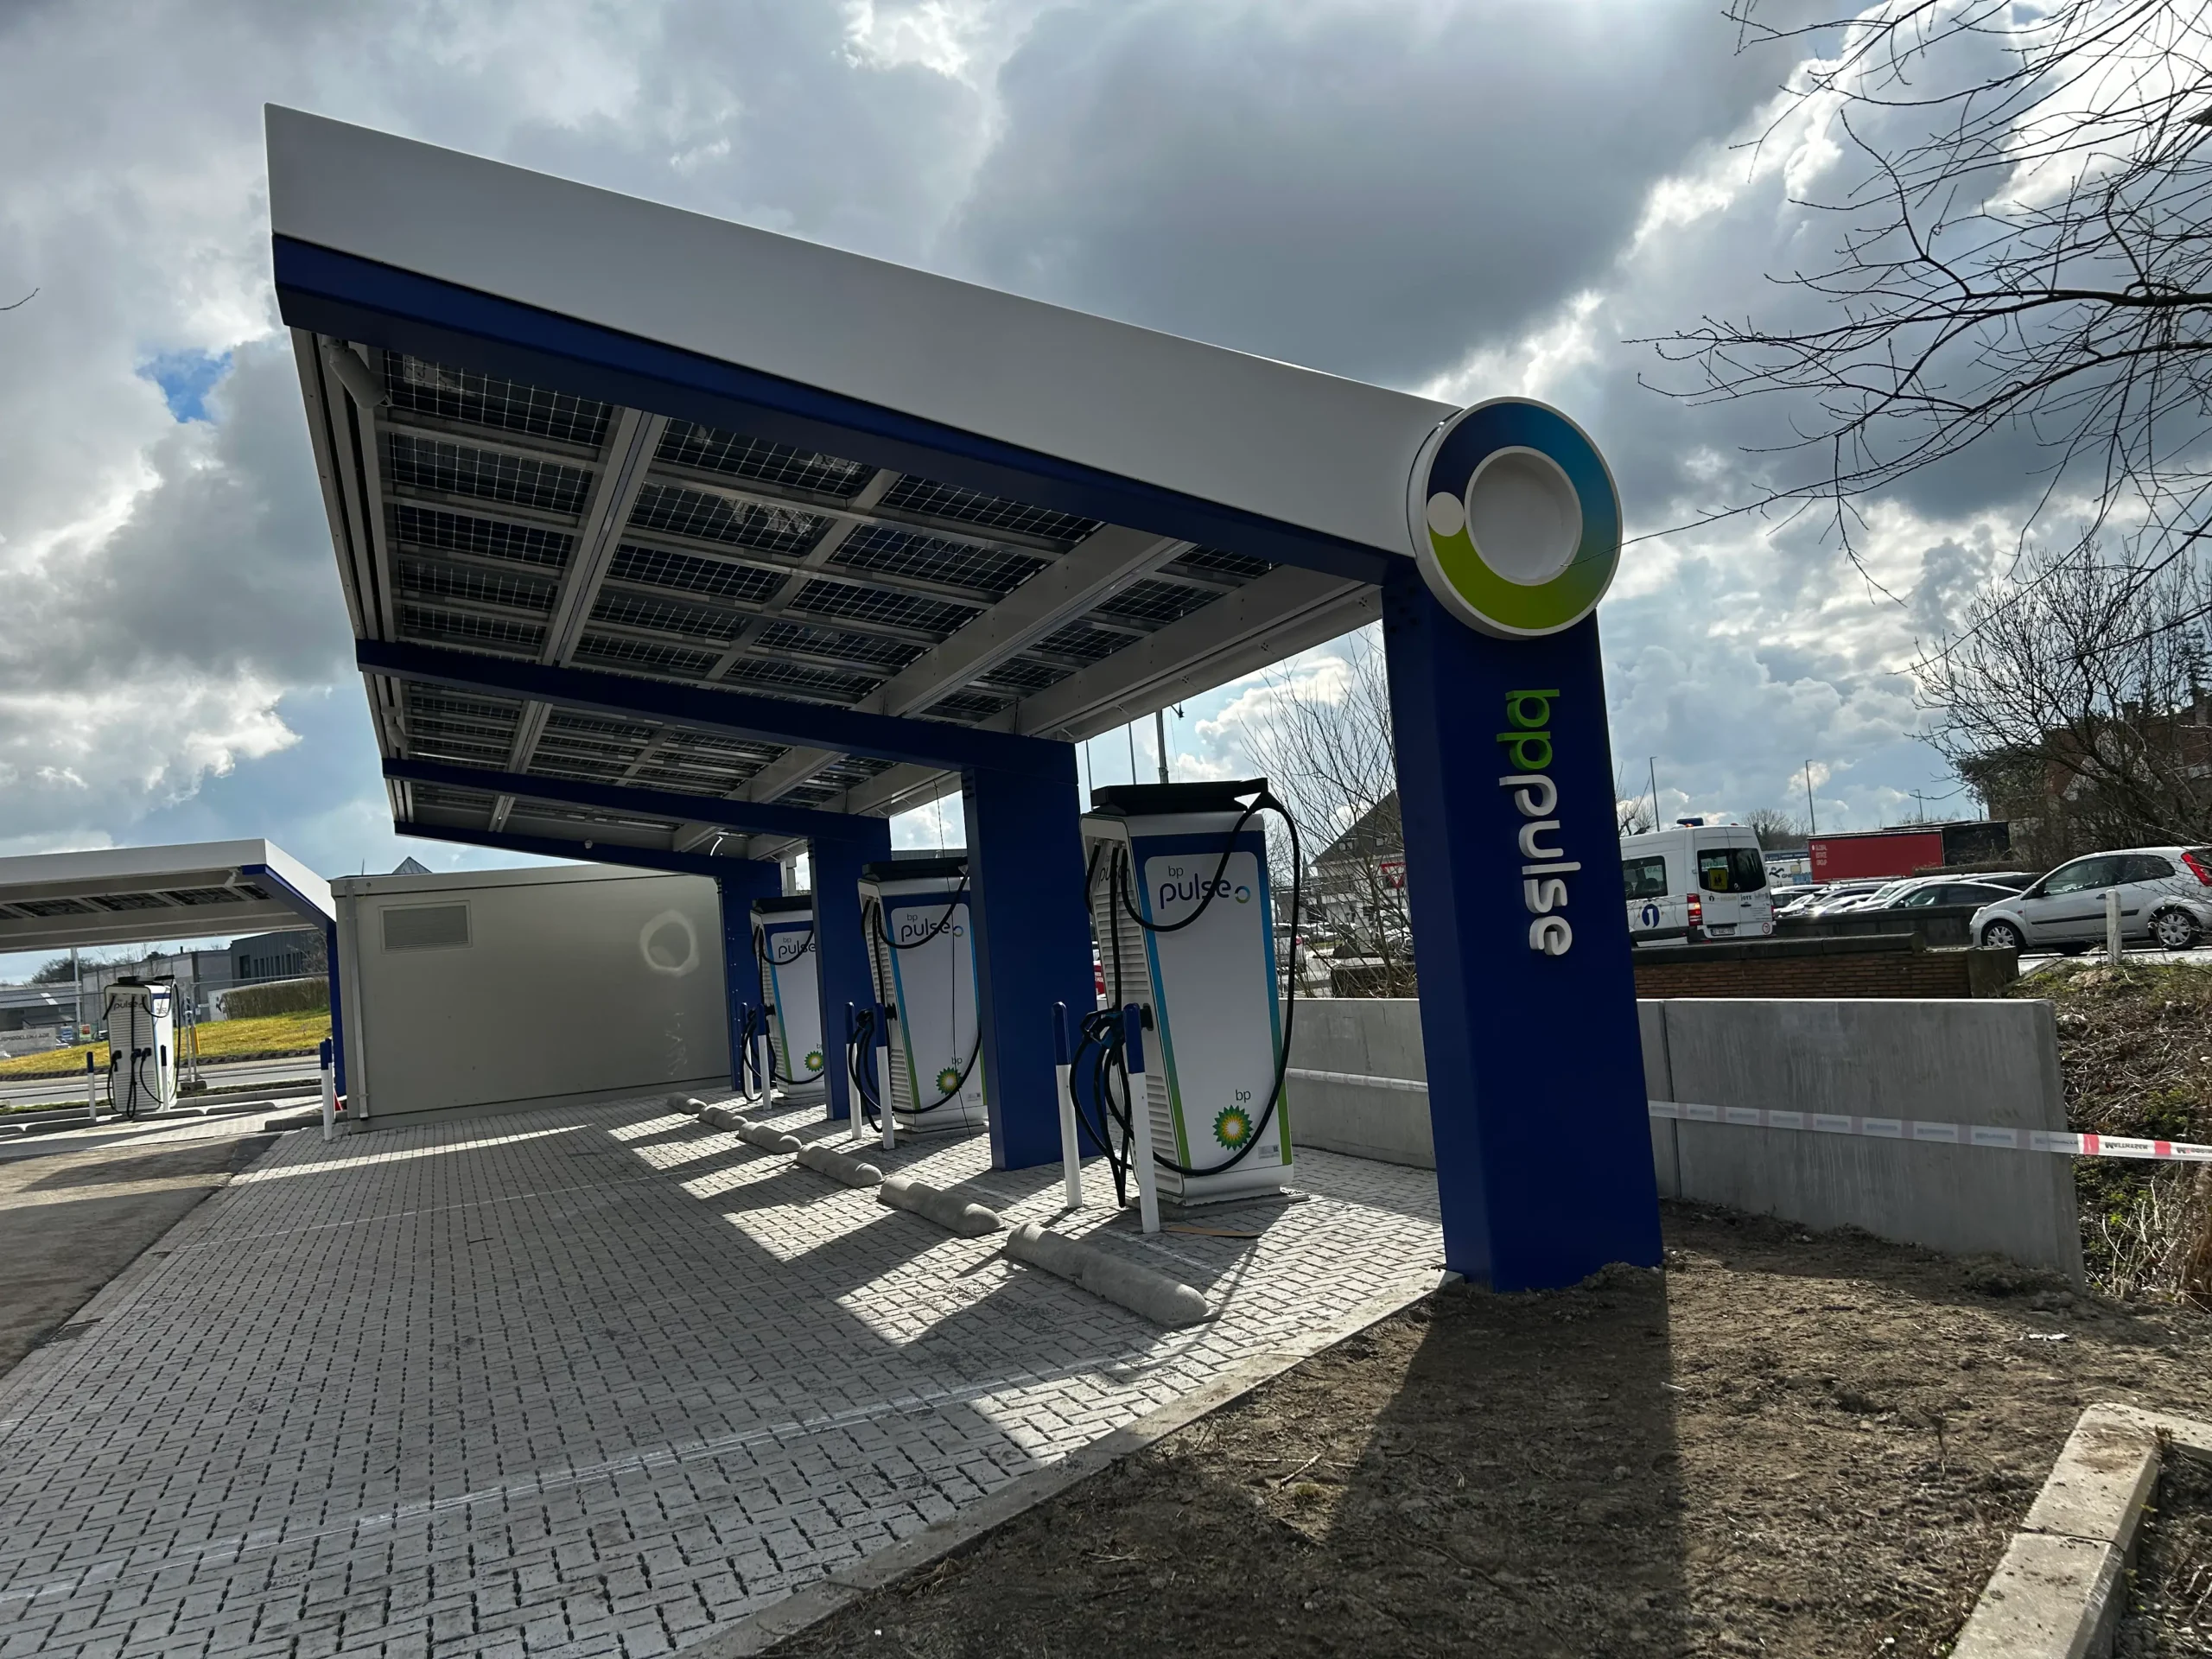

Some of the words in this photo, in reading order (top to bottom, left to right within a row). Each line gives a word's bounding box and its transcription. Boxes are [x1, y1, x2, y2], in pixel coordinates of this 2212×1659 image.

[1168, 866, 1184, 880] bp
[1160, 873, 1231, 909] pulse
[907, 913, 918, 922] bp
[901, 918, 950, 942] pulse
[779, 940, 816, 959] pulse
[951, 1057, 963, 1065] bp
[1235, 1089, 1251, 1103] bp
